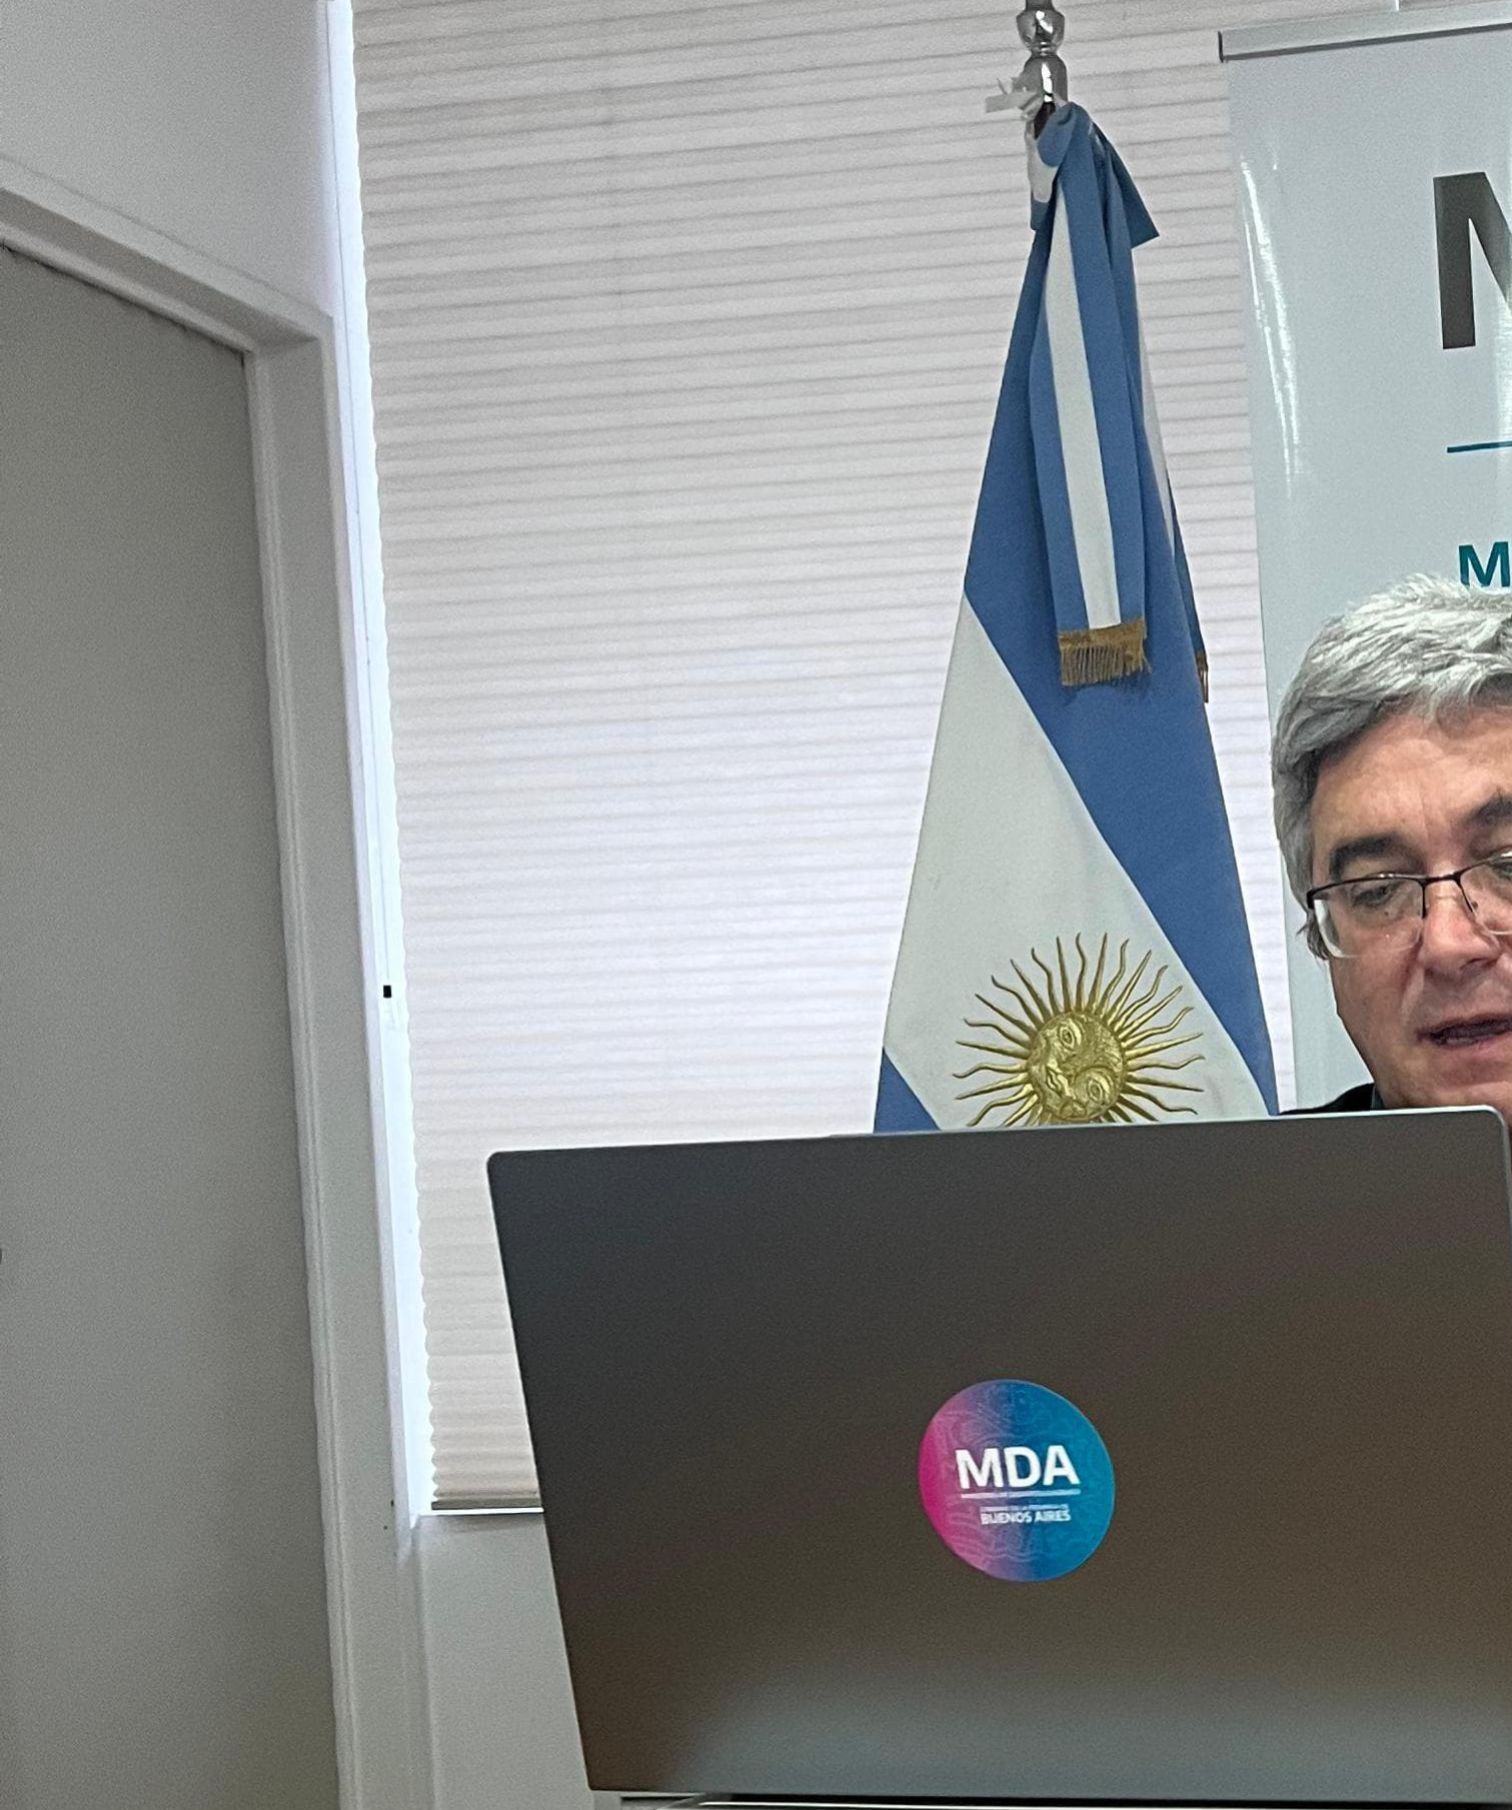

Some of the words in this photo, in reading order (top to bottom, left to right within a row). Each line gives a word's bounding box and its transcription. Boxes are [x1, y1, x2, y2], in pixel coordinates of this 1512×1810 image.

[955, 1445, 1081, 1490] MDA
[980, 1510, 1033, 1525] BUENOS
[1034, 1509, 1072, 1522] AIRES
